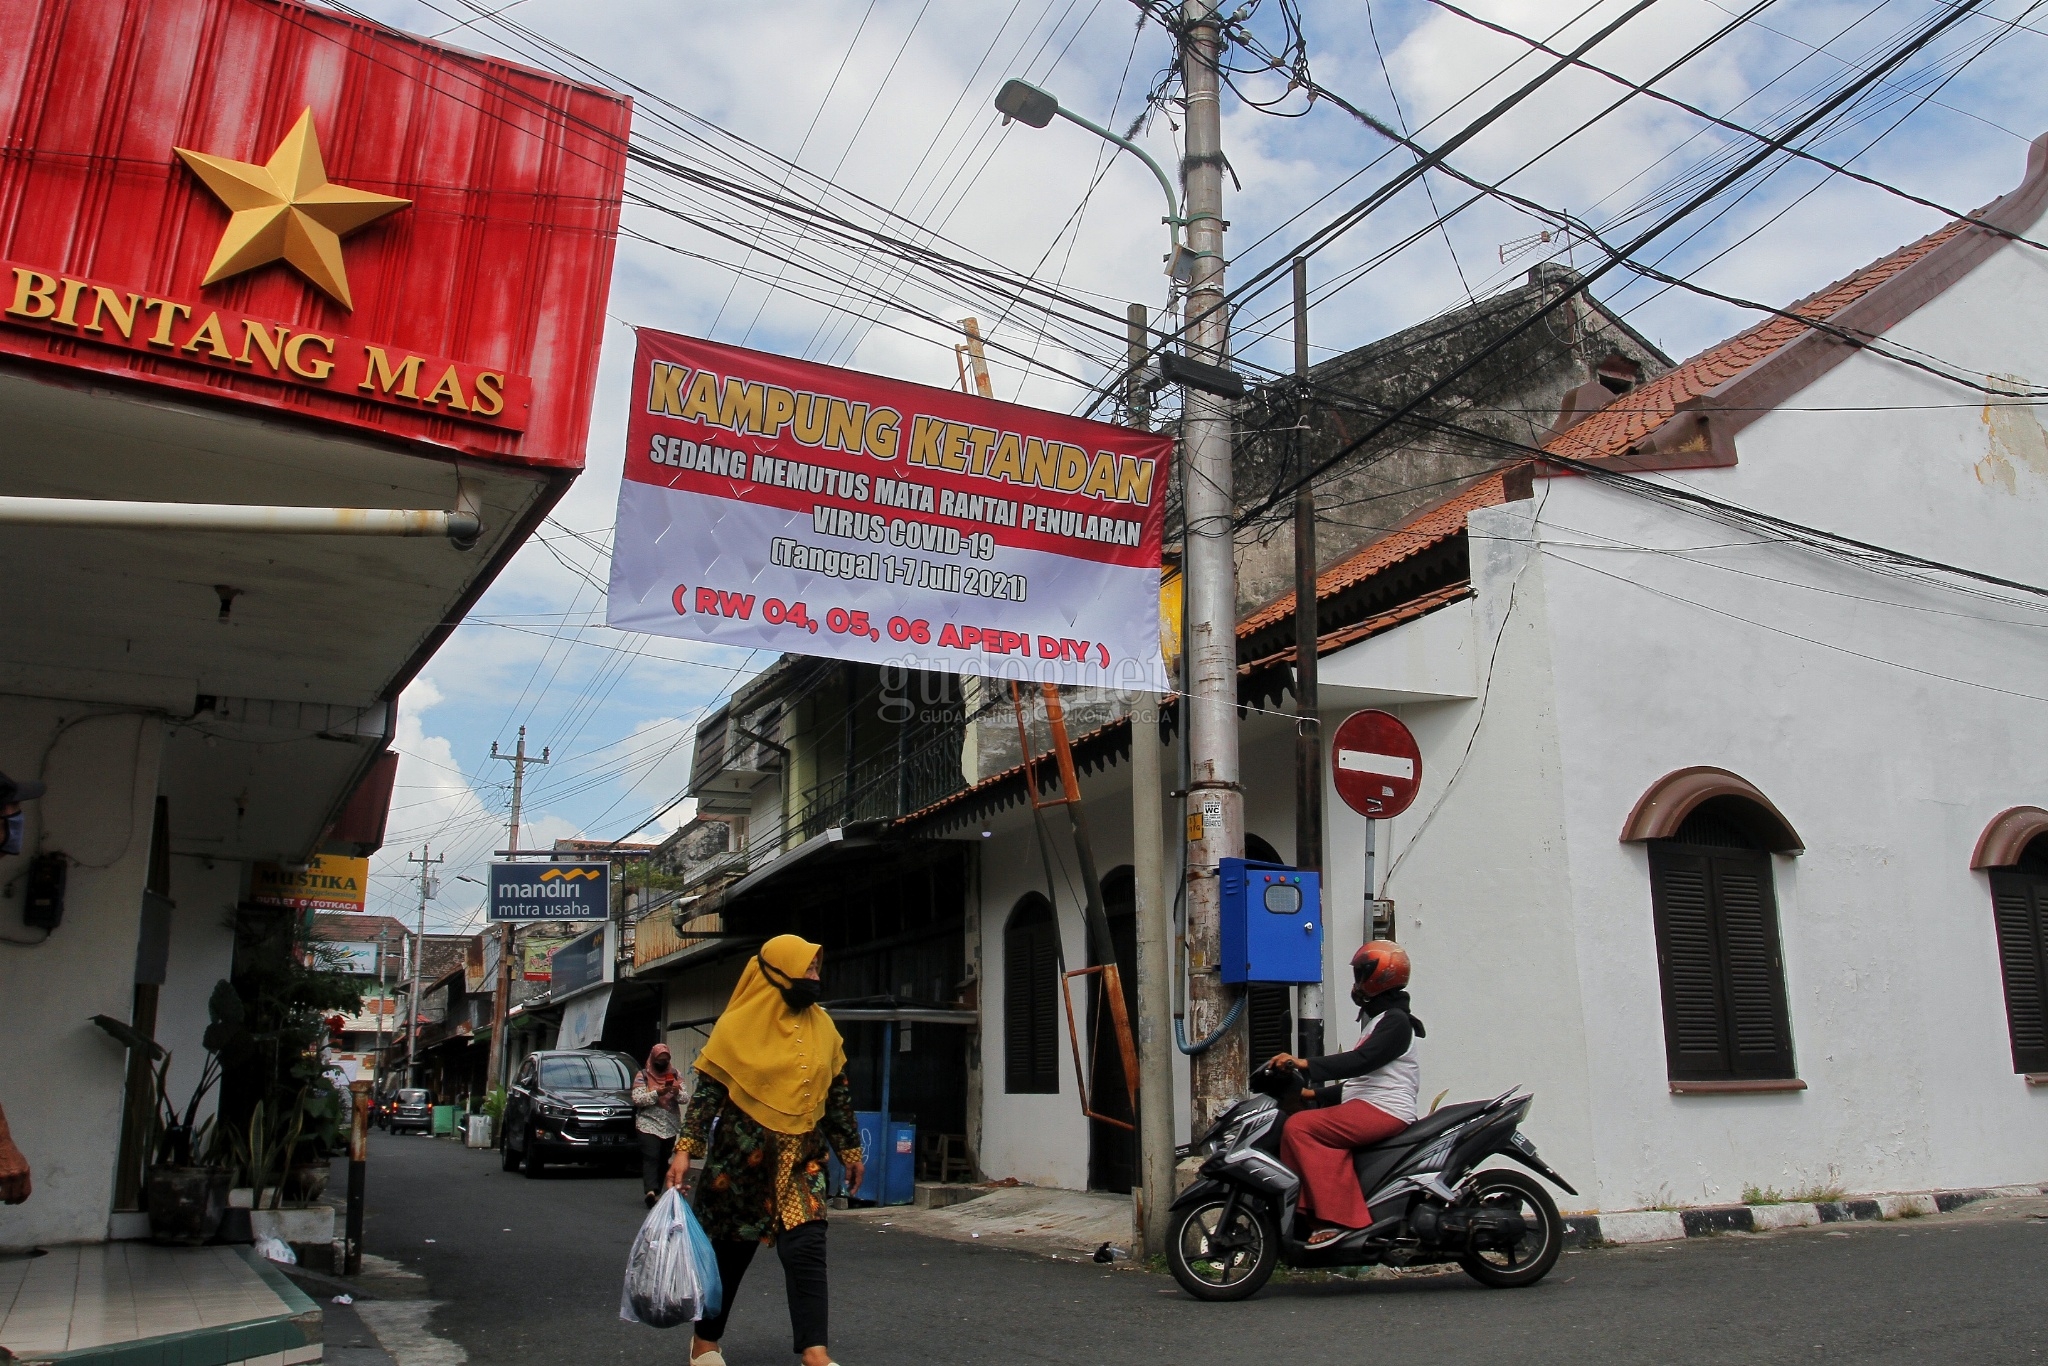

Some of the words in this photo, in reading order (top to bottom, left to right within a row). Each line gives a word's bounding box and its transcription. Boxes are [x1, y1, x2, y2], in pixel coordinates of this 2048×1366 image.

[5, 267, 336, 381] BINTANG
[357, 344, 506, 417] MAS
[647, 360, 901, 462] KAMPUNG
[907, 413, 1157, 508] KETANDAN
[649, 434, 748, 480] SEDANG
[750, 453, 871, 503] MEMUTUS
[873, 476, 935, 514] MATA
[938, 488, 1019, 528] RANTAI
[1020, 503, 1142, 548] PENULARAN
[812, 504, 886, 544] VIRUS
[888, 518, 996, 562] COVID-19
[769, 535, 881, 582] (Tanggal
[882, 554, 917, 586] 1-7
[917, 560, 961, 595] Juli
[962, 566, 1028, 603] 2021)
[694, 586, 757, 621] RW
[761, 597, 819, 635] 04,
[825, 606, 881, 643] 05,
[886, 615, 932, 645] 06
[937, 622, 1032, 658] APEPI
[1038, 635, 1091, 664] DIY
[261, 870, 358, 891] MUSTIKA
[498, 878, 581, 899] mandiri
[498, 902, 541, 916] mitra
[544, 900, 591, 916] usaha
